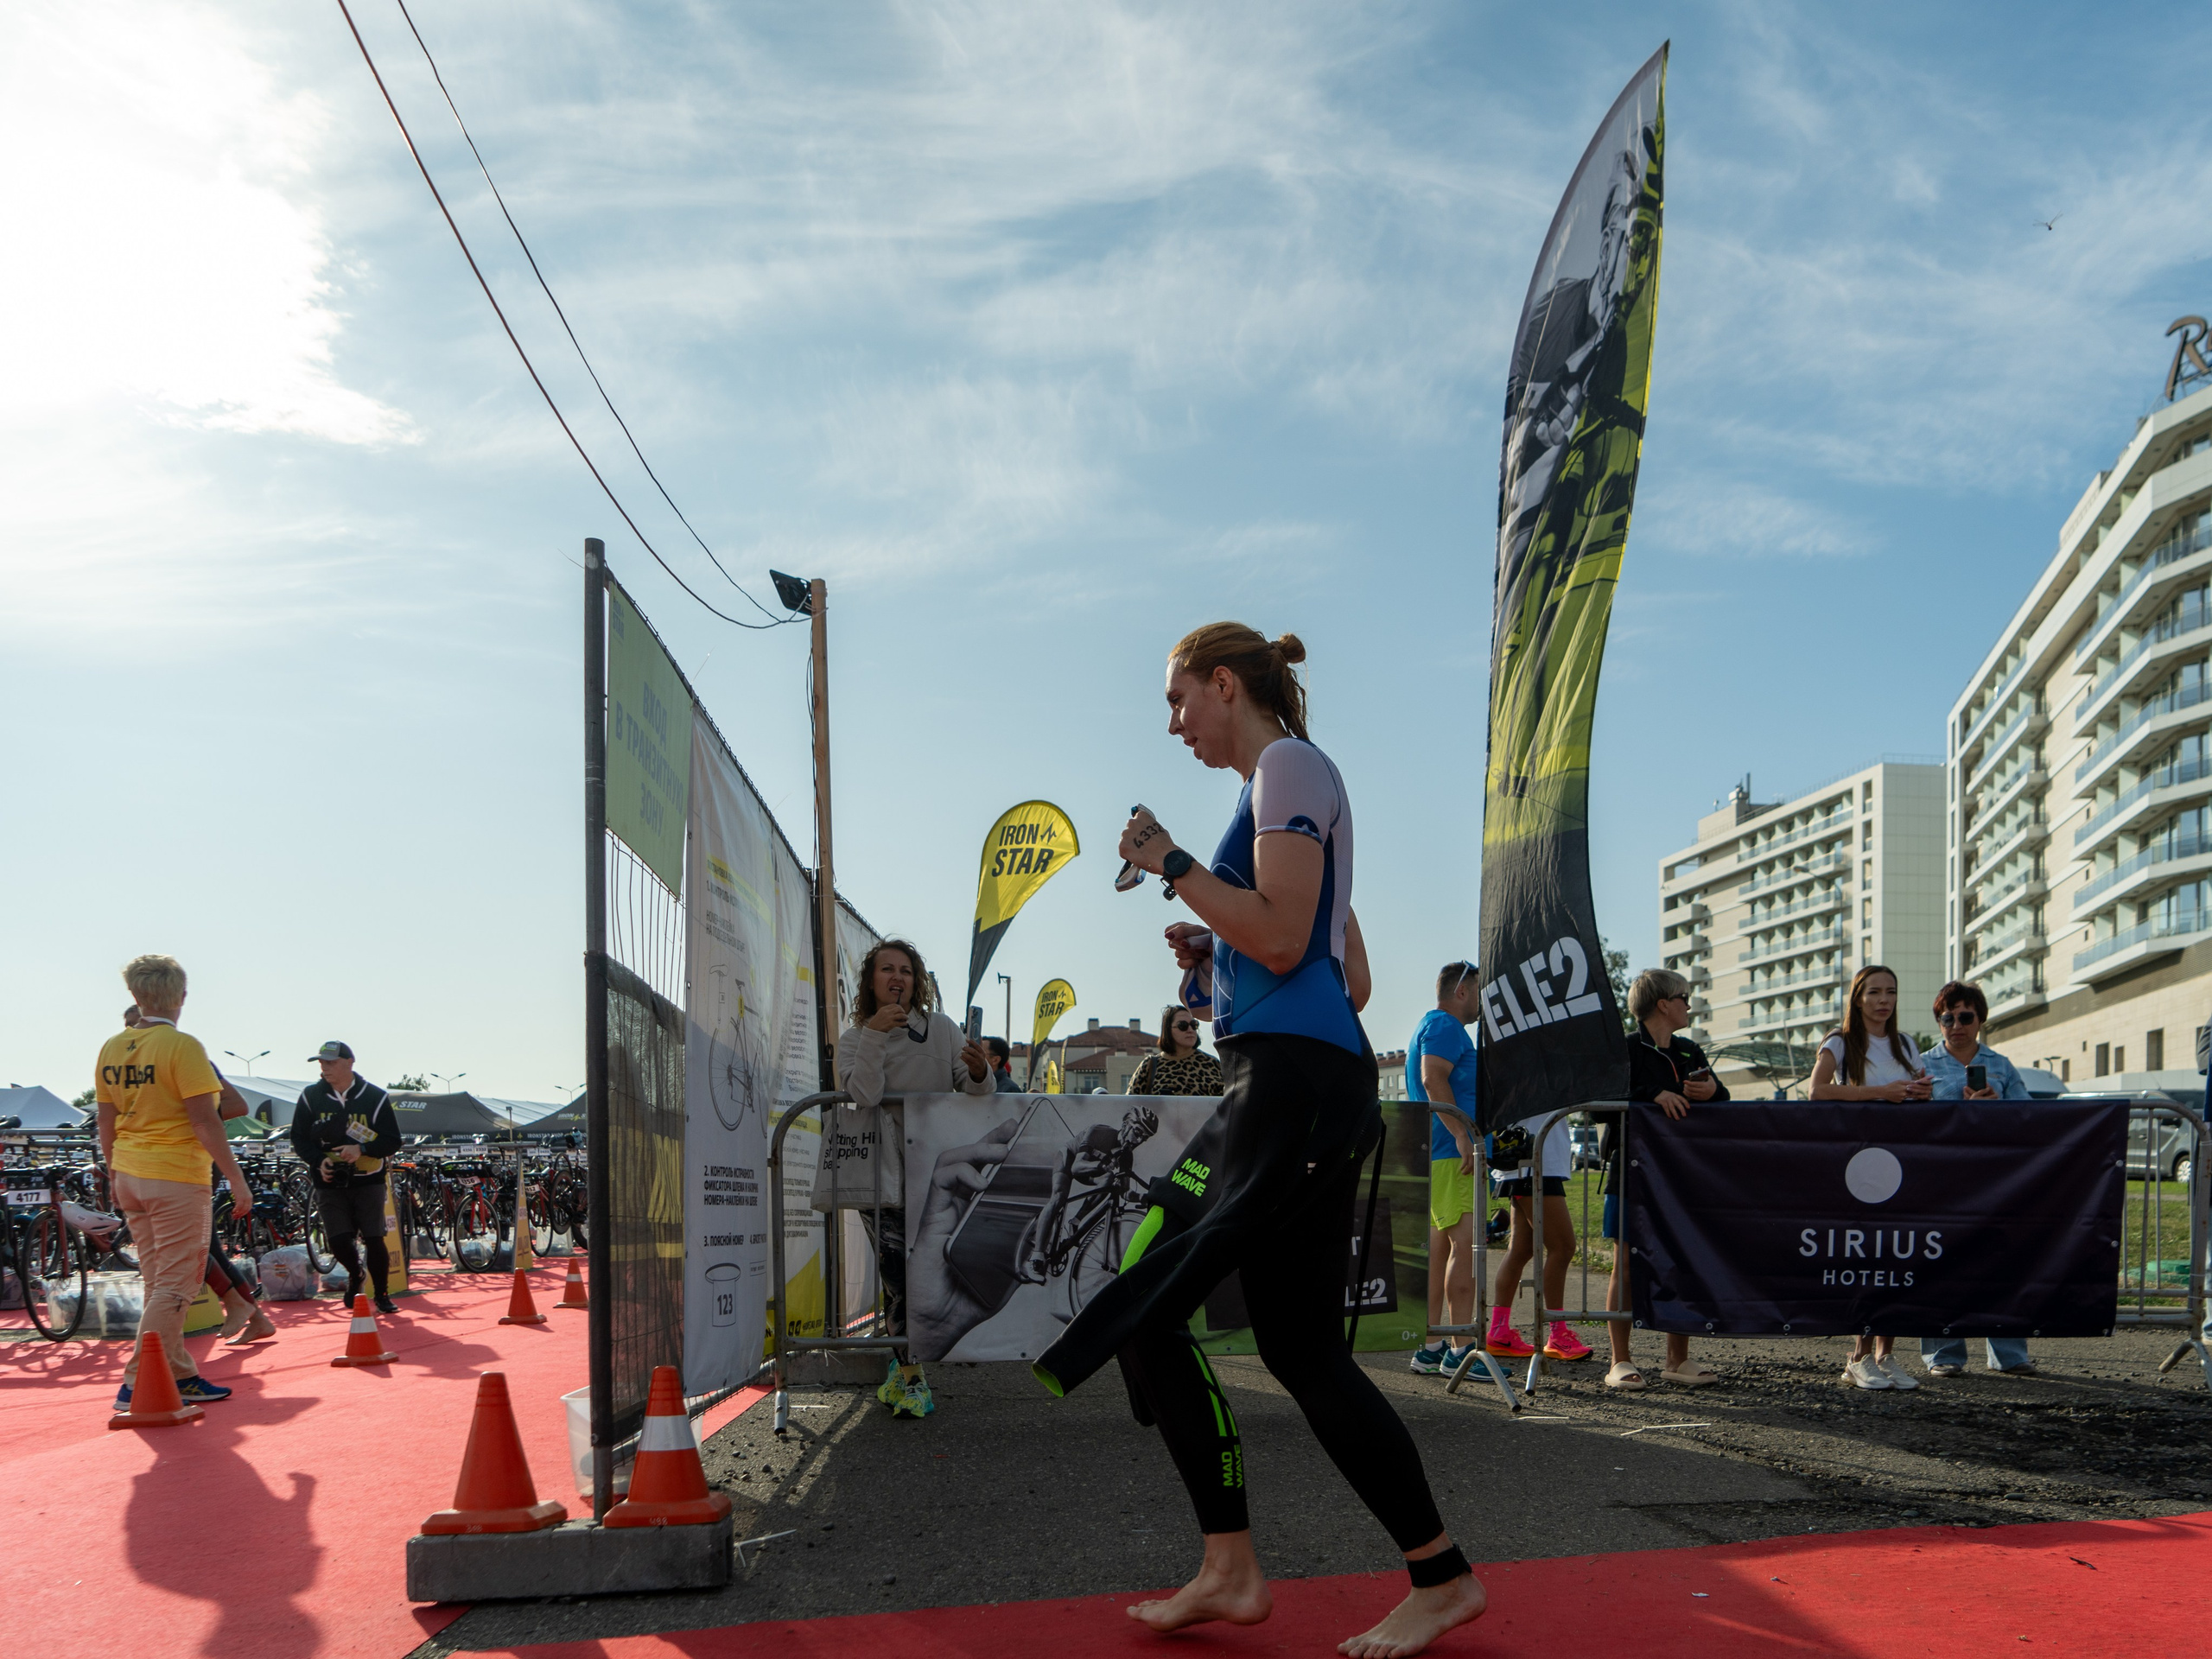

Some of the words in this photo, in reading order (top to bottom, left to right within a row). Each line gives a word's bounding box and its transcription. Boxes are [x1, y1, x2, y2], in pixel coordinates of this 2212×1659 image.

[642, 681, 667, 753] ВХОД
[615, 700, 623, 741] В
[626, 712, 683, 815] ТРАНЗИТНУЮ
[639, 781, 664, 838] ЗОНУ
[999, 823, 1040, 847] IRON
[991, 847, 1054, 878] STAR
[1041, 989, 1058, 1003] IRON
[1481, 937, 1602, 1042] ELE2
[1039, 1001, 1065, 1019] STAR
[399, 1101, 428, 1109] STAR
[861, 1131, 881, 1145] Hil
[824, 1147, 868, 1160] shpping
[823, 1159, 840, 1170] ba.
[1181, 1158, 1211, 1180] MAD
[704, 1179, 732, 1191] ФИКСАТОРА
[1172, 1169, 1206, 1197] WAVE
[16, 1192, 40, 1203] 4177
[709, 1232, 732, 1247] ПОЯСНОЙ
[1798, 1227, 1943, 1261] SIRIUS
[1821, 1269, 1915, 1287] HOTELS
[717, 1294, 733, 1315] 123
[1402, 1330, 1419, 1341] 0+
[1221, 1451, 1234, 1487] MAD
[1233, 1444, 1243, 1489] WAVE
